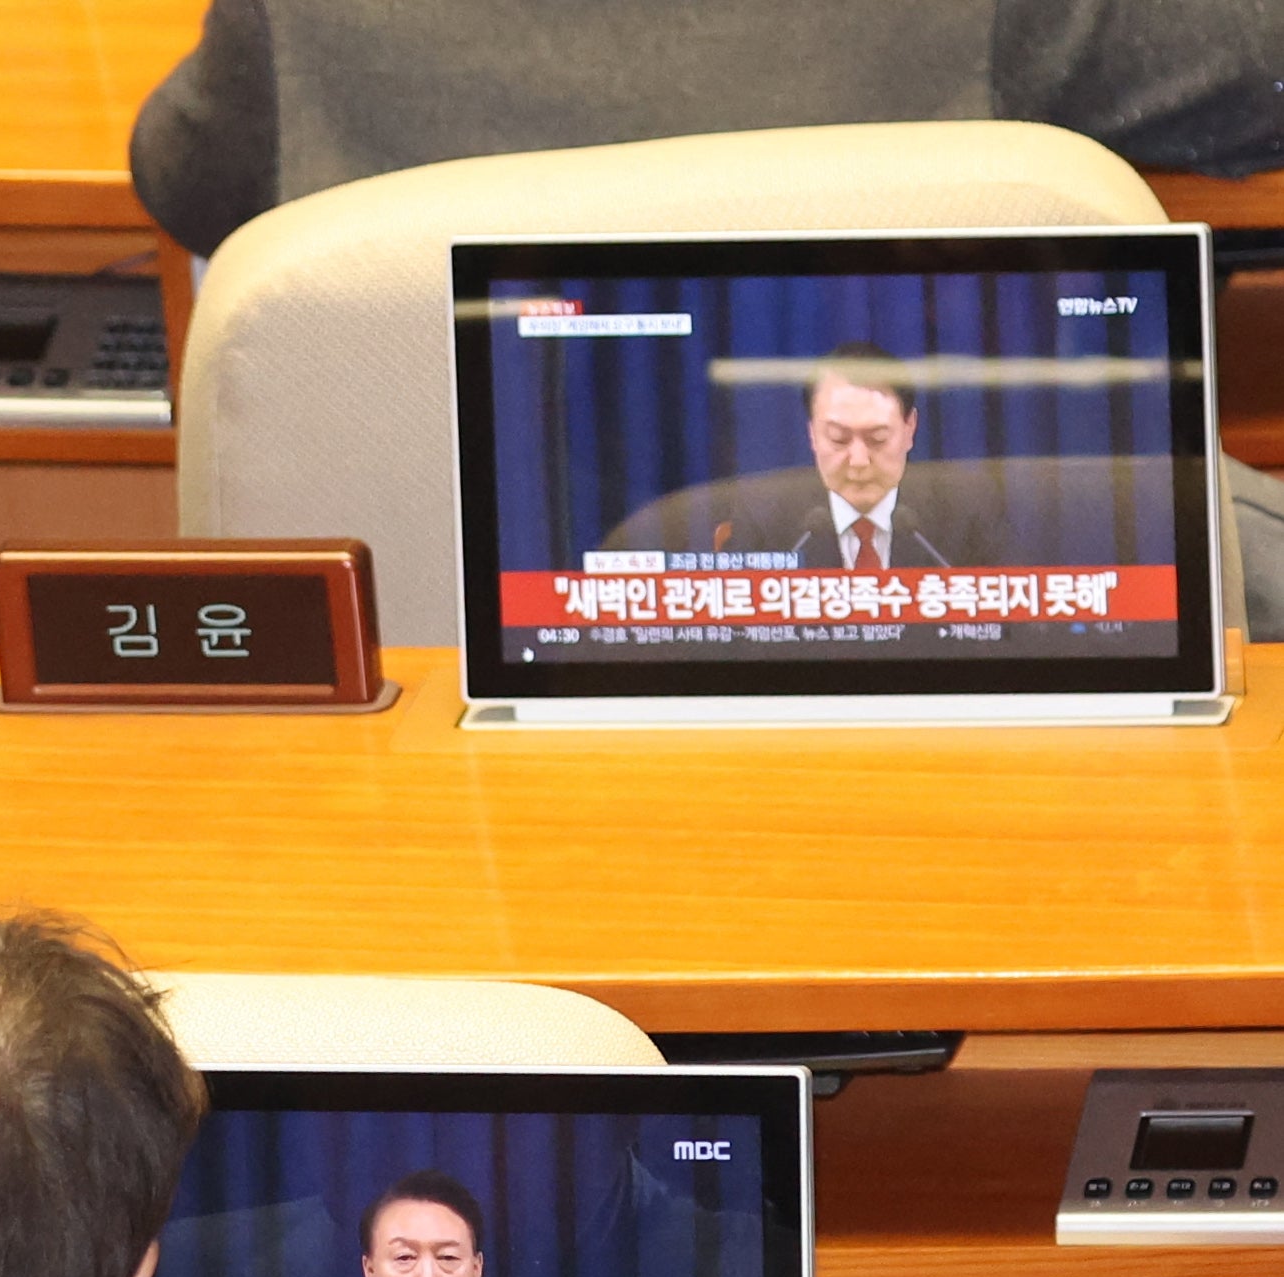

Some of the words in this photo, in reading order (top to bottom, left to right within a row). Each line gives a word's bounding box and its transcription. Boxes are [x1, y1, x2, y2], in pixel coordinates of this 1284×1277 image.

[1057, 297, 1138, 316] 연합뉴스TV
[555, 575, 658, 621] "새벽인
[661, 576, 757, 620] 관계로
[759, 574, 913, 619] 의결정족수
[915, 572, 1040, 618] 충족되지
[1042, 570, 1119, 616] 못해"
[537, 628, 581, 643] 04:30
[677, 626, 703, 642] 사태
[802, 626, 830, 641] 뉴스
[833, 625, 859, 641] 보고
[674, 1141, 731, 1160] MBC
